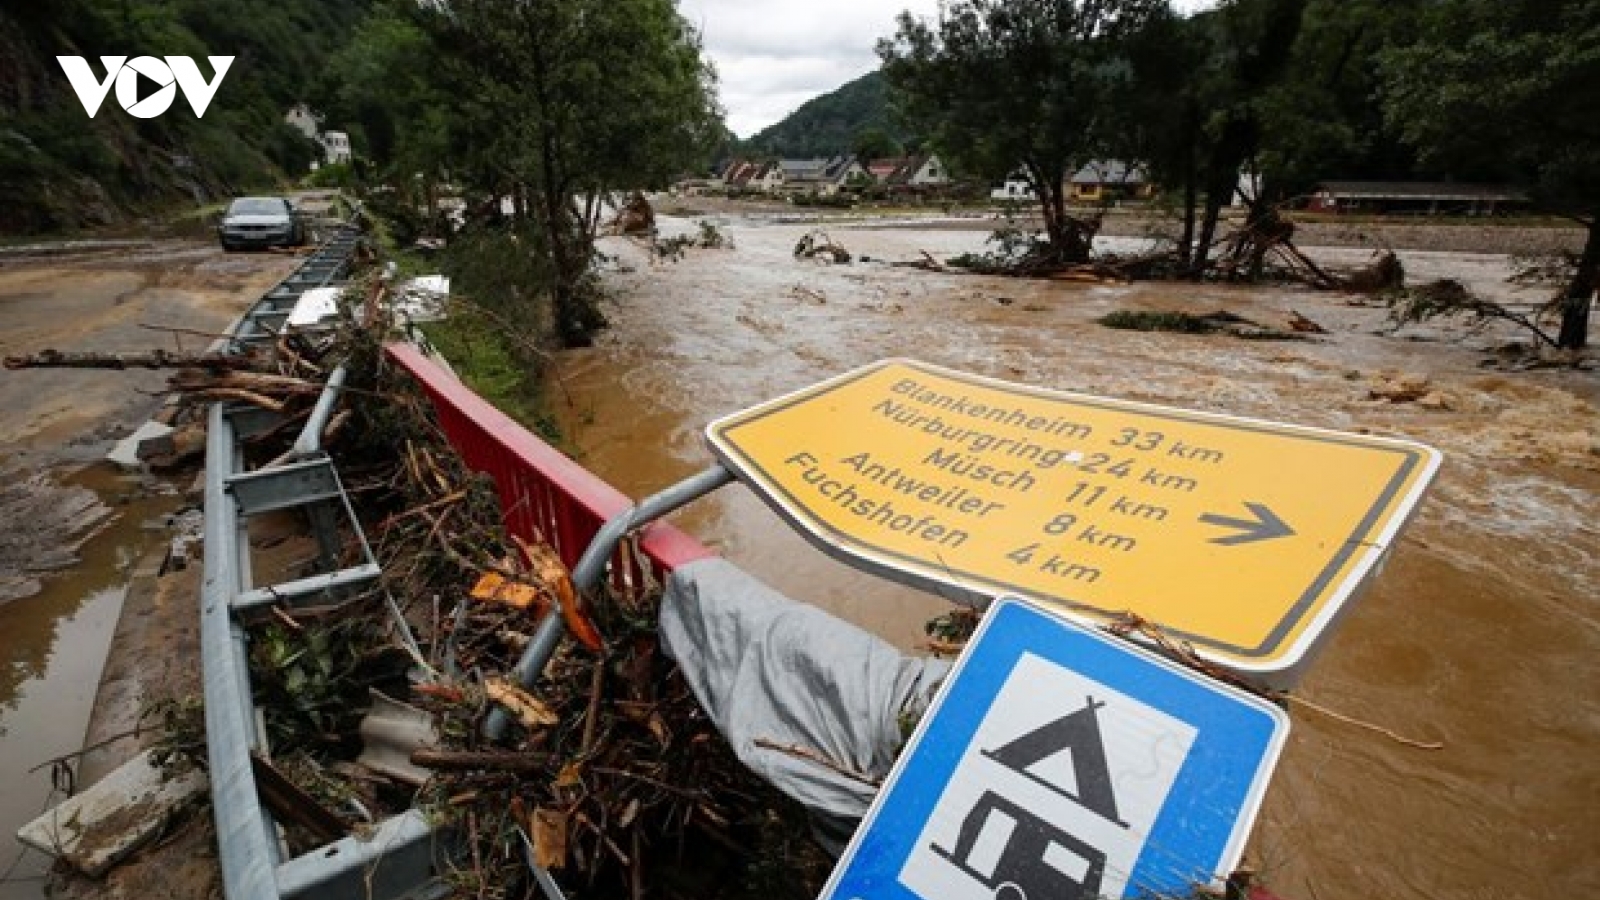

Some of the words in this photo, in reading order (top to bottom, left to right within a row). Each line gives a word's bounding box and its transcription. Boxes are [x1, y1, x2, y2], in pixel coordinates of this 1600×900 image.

[872, 399, 1068, 469] Nürburgring
[1079, 452, 1135, 480] 24
[1140, 467, 1197, 492] km
[890, 378, 1092, 440] Blankenheim
[1110, 428, 1164, 450] 33
[1167, 440, 1224, 464] km
[785, 452, 970, 549] Fuchshofen
[1006, 542, 1040, 565] 4
[1040, 554, 1101, 583] km
[840, 452, 1005, 517] Antweiler
[1043, 513, 1077, 535] 8
[1077, 525, 1136, 552] km
[922, 447, 1036, 492] Müsch
[1066, 481, 1107, 506] 11
[1110, 496, 1168, 521] km
